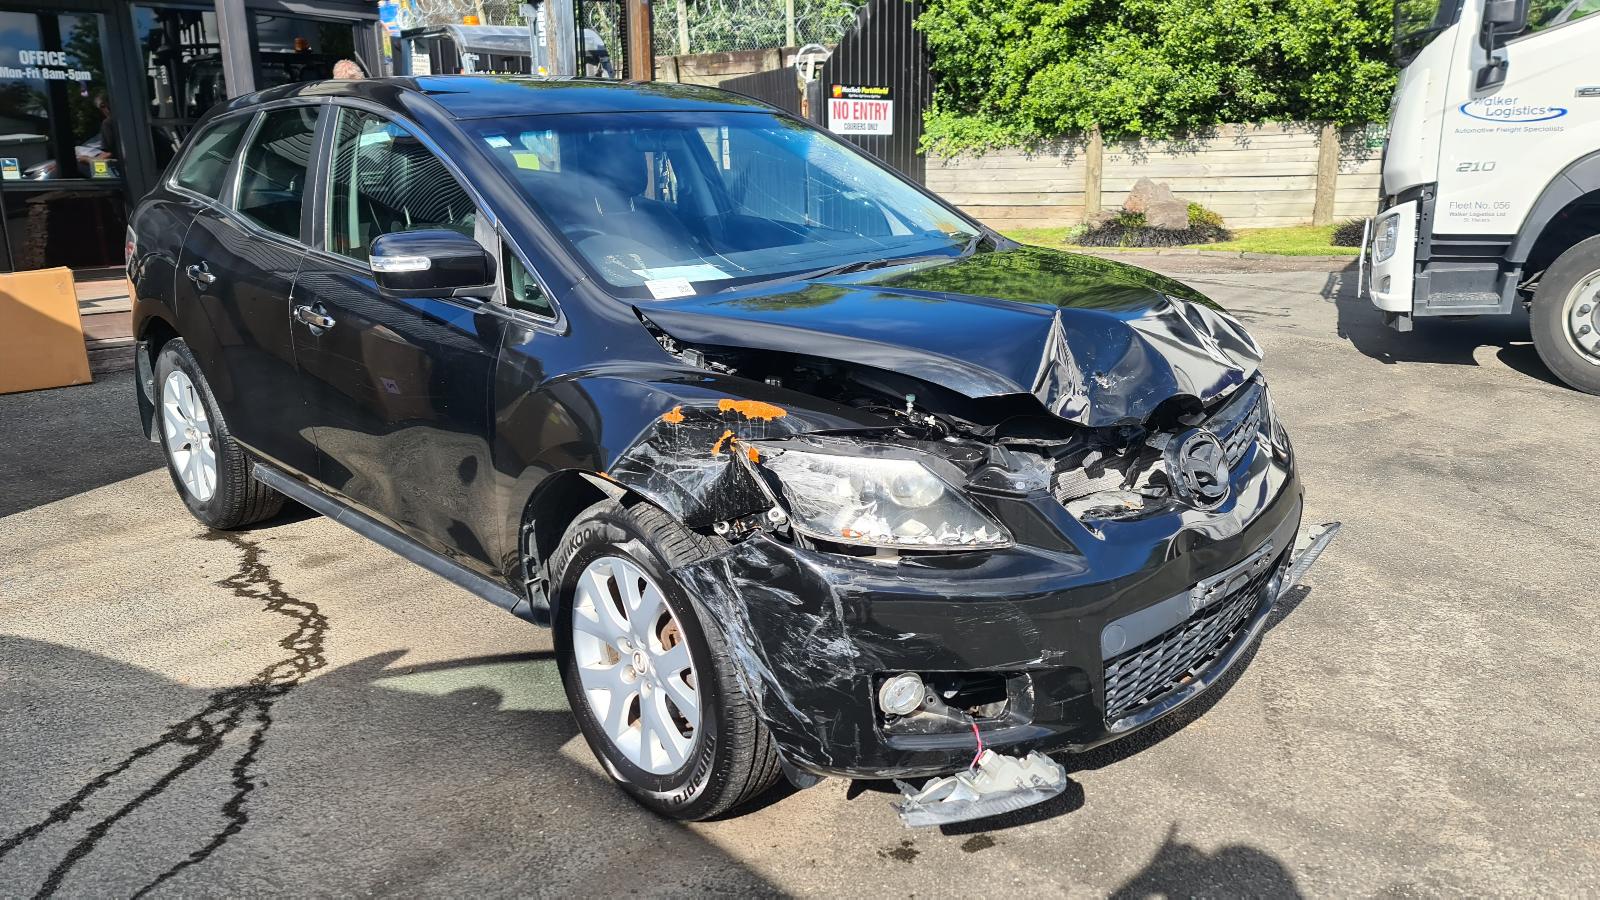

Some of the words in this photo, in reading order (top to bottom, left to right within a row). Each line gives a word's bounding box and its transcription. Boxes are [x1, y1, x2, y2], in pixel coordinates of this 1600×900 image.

[18, 50, 67, 66] OFFICE
[0, 66, 41, 79] Mon-Fri
[43, 68, 92, 81] 8am-5pm
[1474, 96, 1518, 106] Walker
[833, 101, 849, 120] NO
[853, 102, 888, 120] ENTRY
[1485, 105, 1546, 118] Logistics
[844, 122, 866, 130] COURIERS
[867, 122, 878, 130] ONLY
[1496, 126, 1522, 134] Freight
[1523, 125, 1564, 133] Specialists
[1456, 161, 1497, 173] 210
[1449, 201, 1472, 209] Fleet
[1474, 201, 1491, 209] No.
